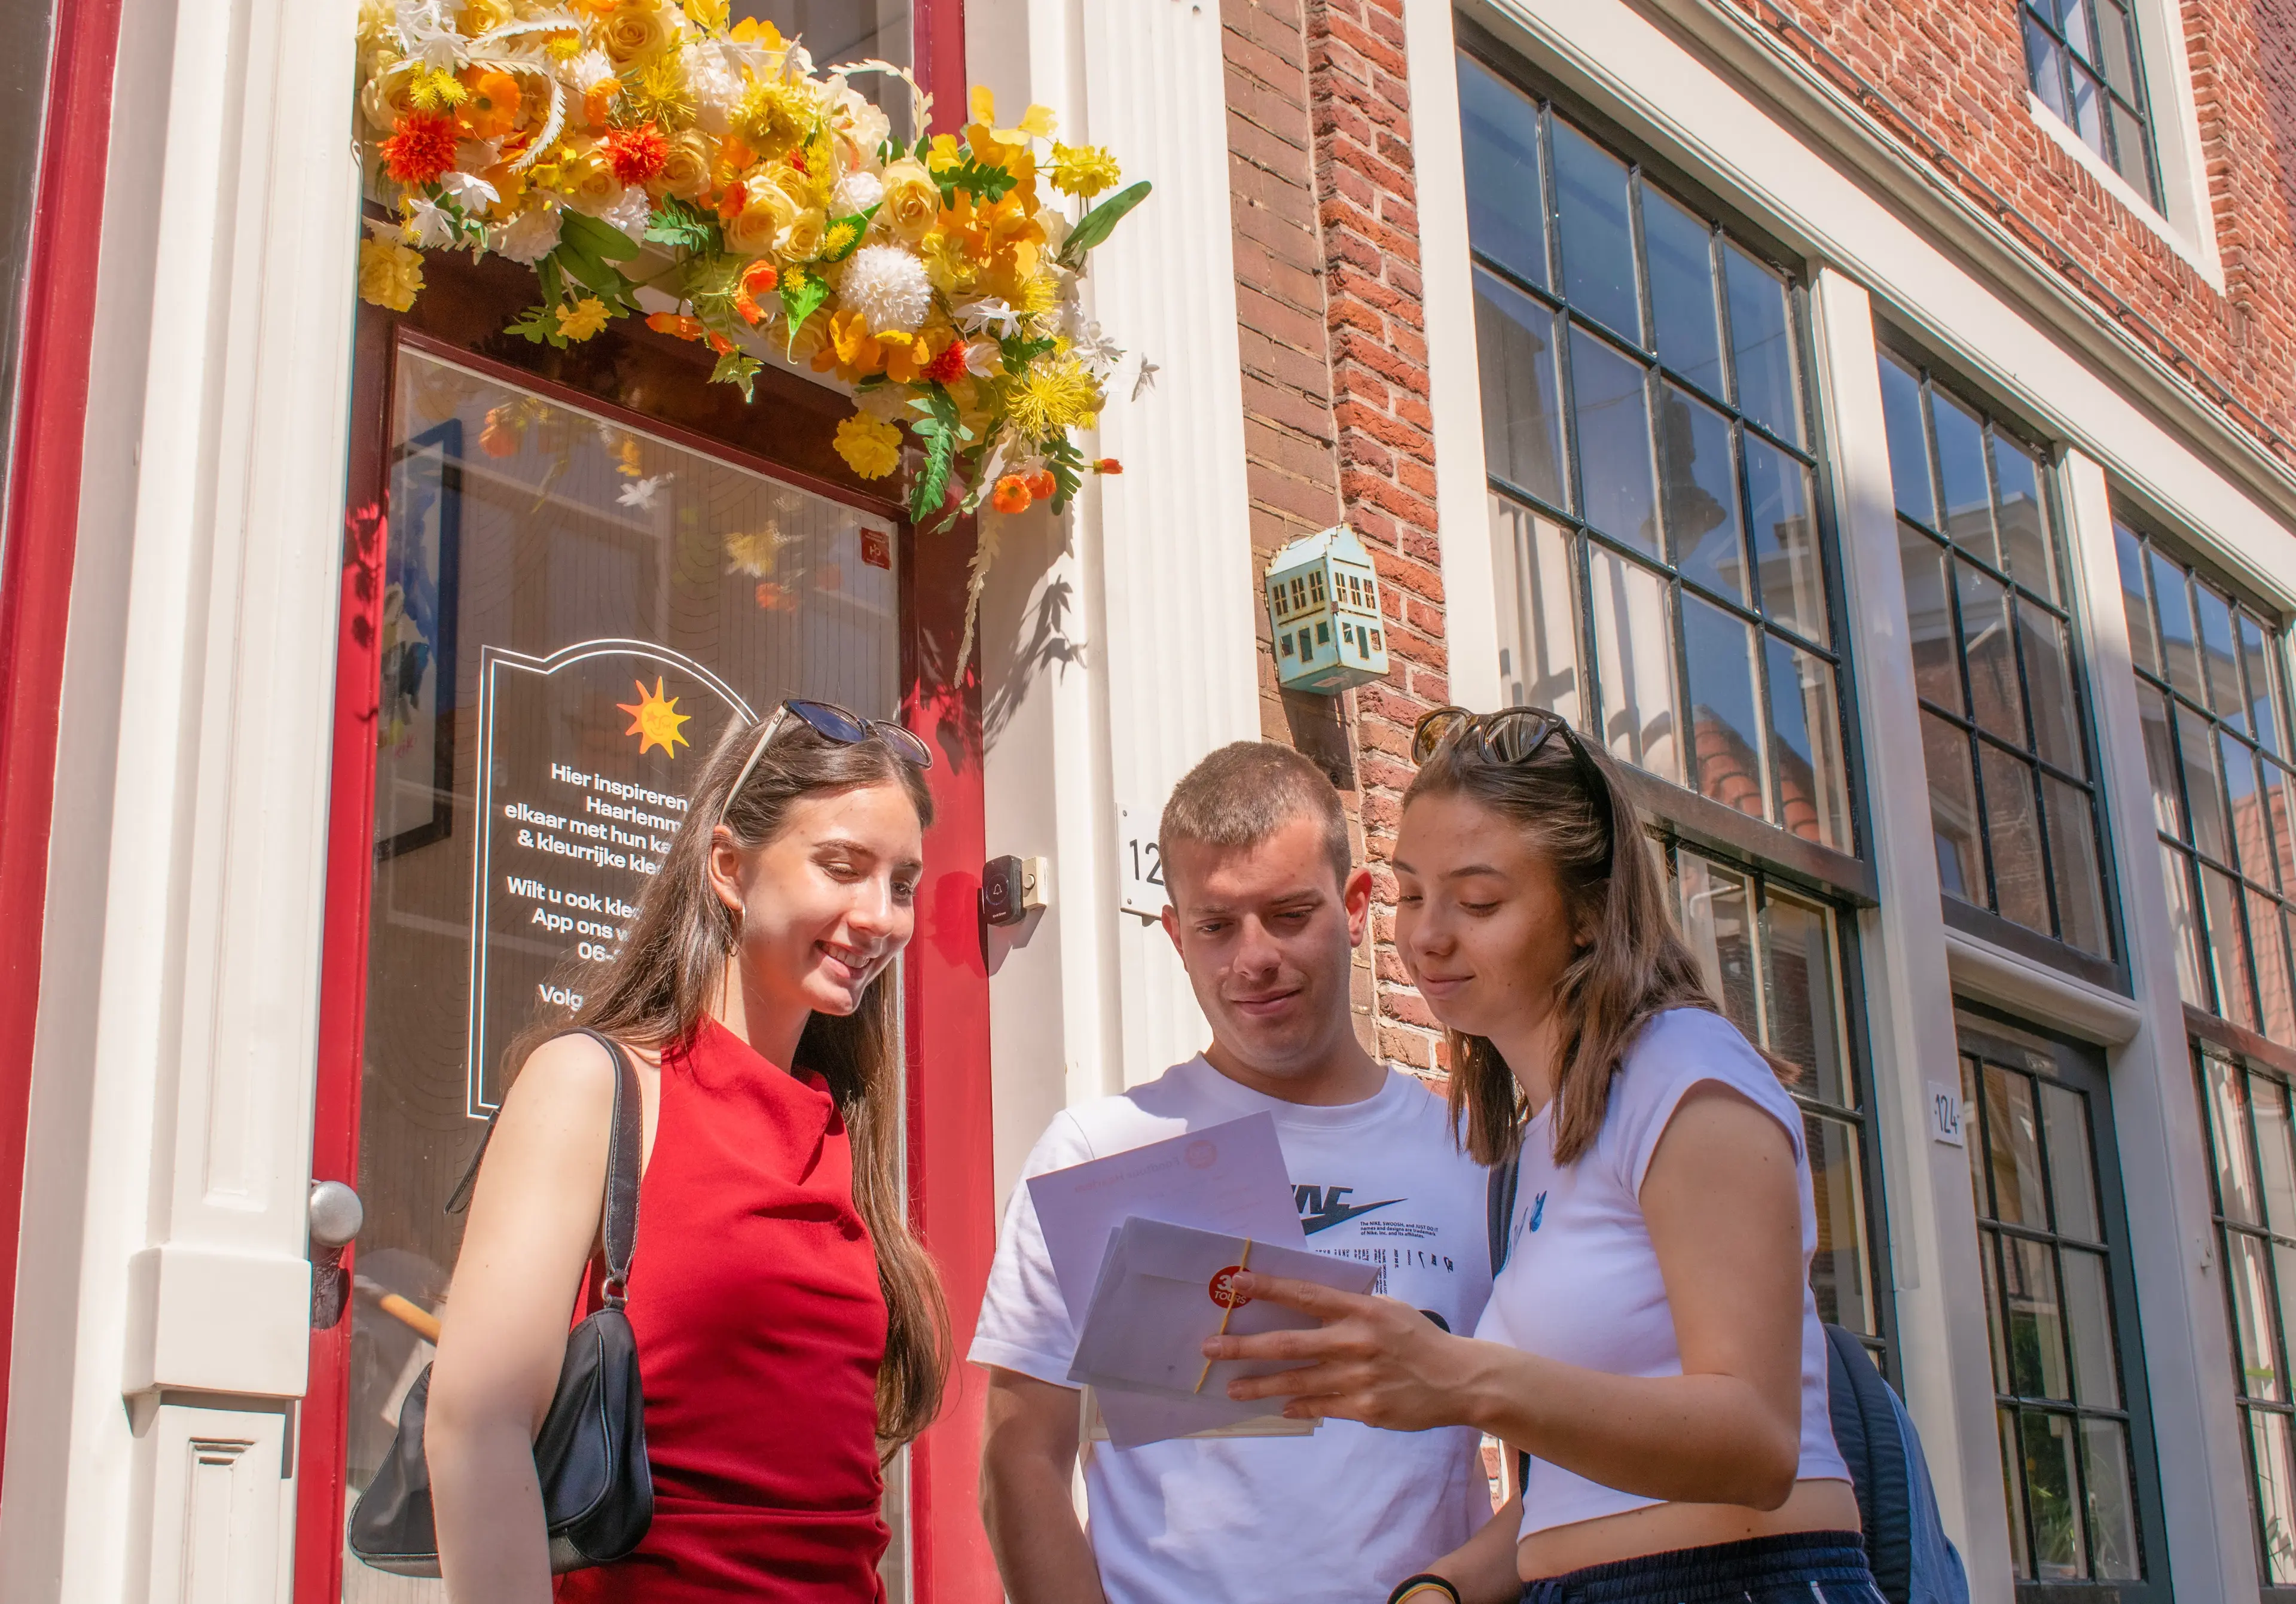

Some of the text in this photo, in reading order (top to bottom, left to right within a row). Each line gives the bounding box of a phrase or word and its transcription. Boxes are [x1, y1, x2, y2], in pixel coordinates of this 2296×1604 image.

[552, 763, 689, 812] Hier inspireren
[505, 803, 567, 830] elkaar
[570, 820, 607, 840] met
[610, 825, 647, 849] hun
[518, 829, 662, 875] & kleurrijke kle
[507, 876, 545, 900] Wilt
[549, 889, 561, 904] u
[565, 893, 603, 913] ook
[532, 907, 573, 934] App
[577, 920, 613, 939] ons
[539, 984, 584, 1011] Volg
[1935, 1093, 1958, 1135] 124
